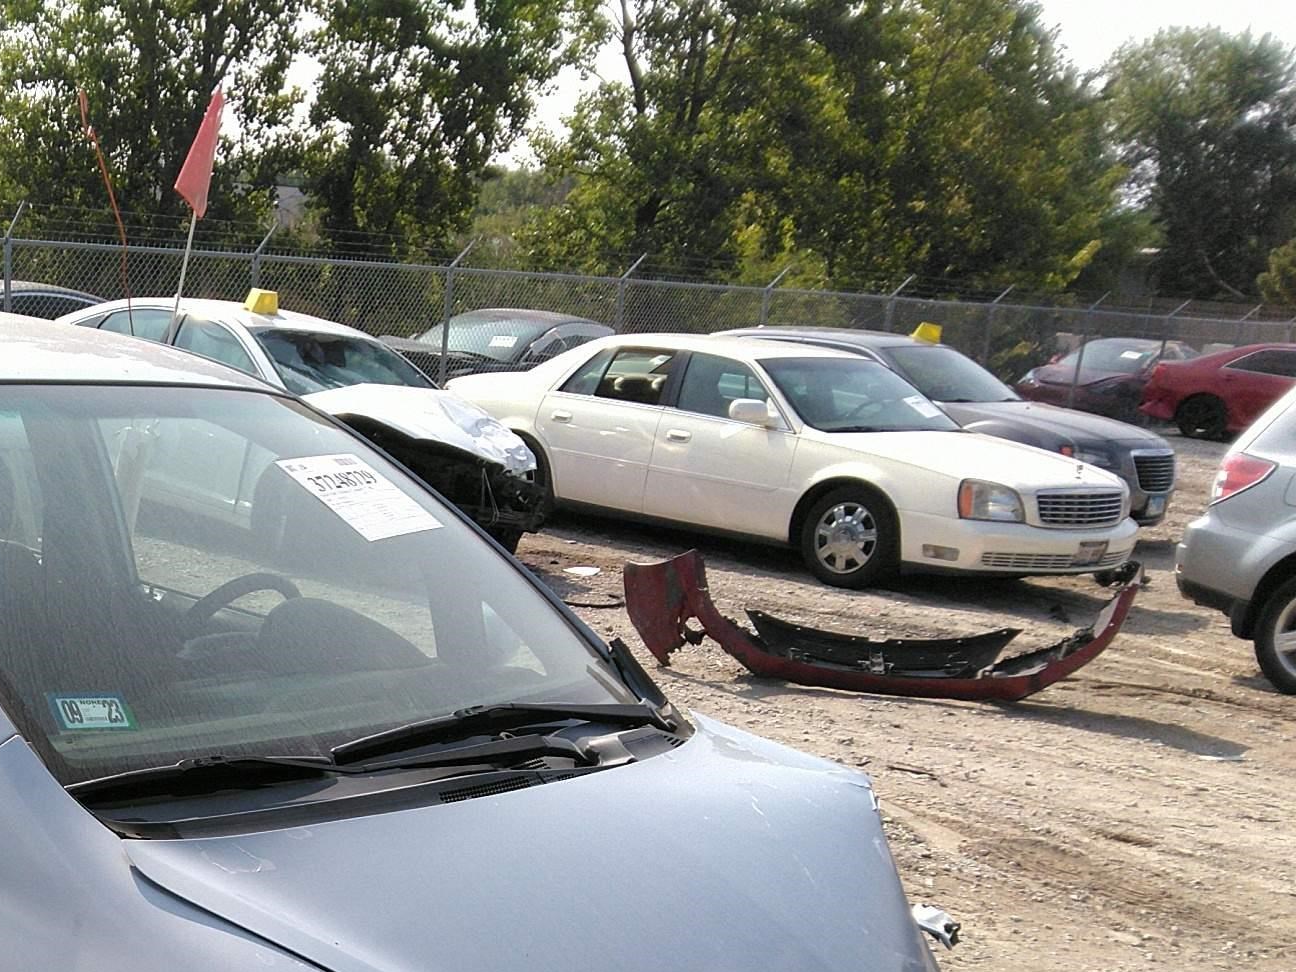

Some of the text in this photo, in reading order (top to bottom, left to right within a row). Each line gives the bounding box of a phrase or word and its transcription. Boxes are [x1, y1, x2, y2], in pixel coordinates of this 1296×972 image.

[307, 469, 377, 492] 37248729
[61, 700, 125, 724] 09 23
